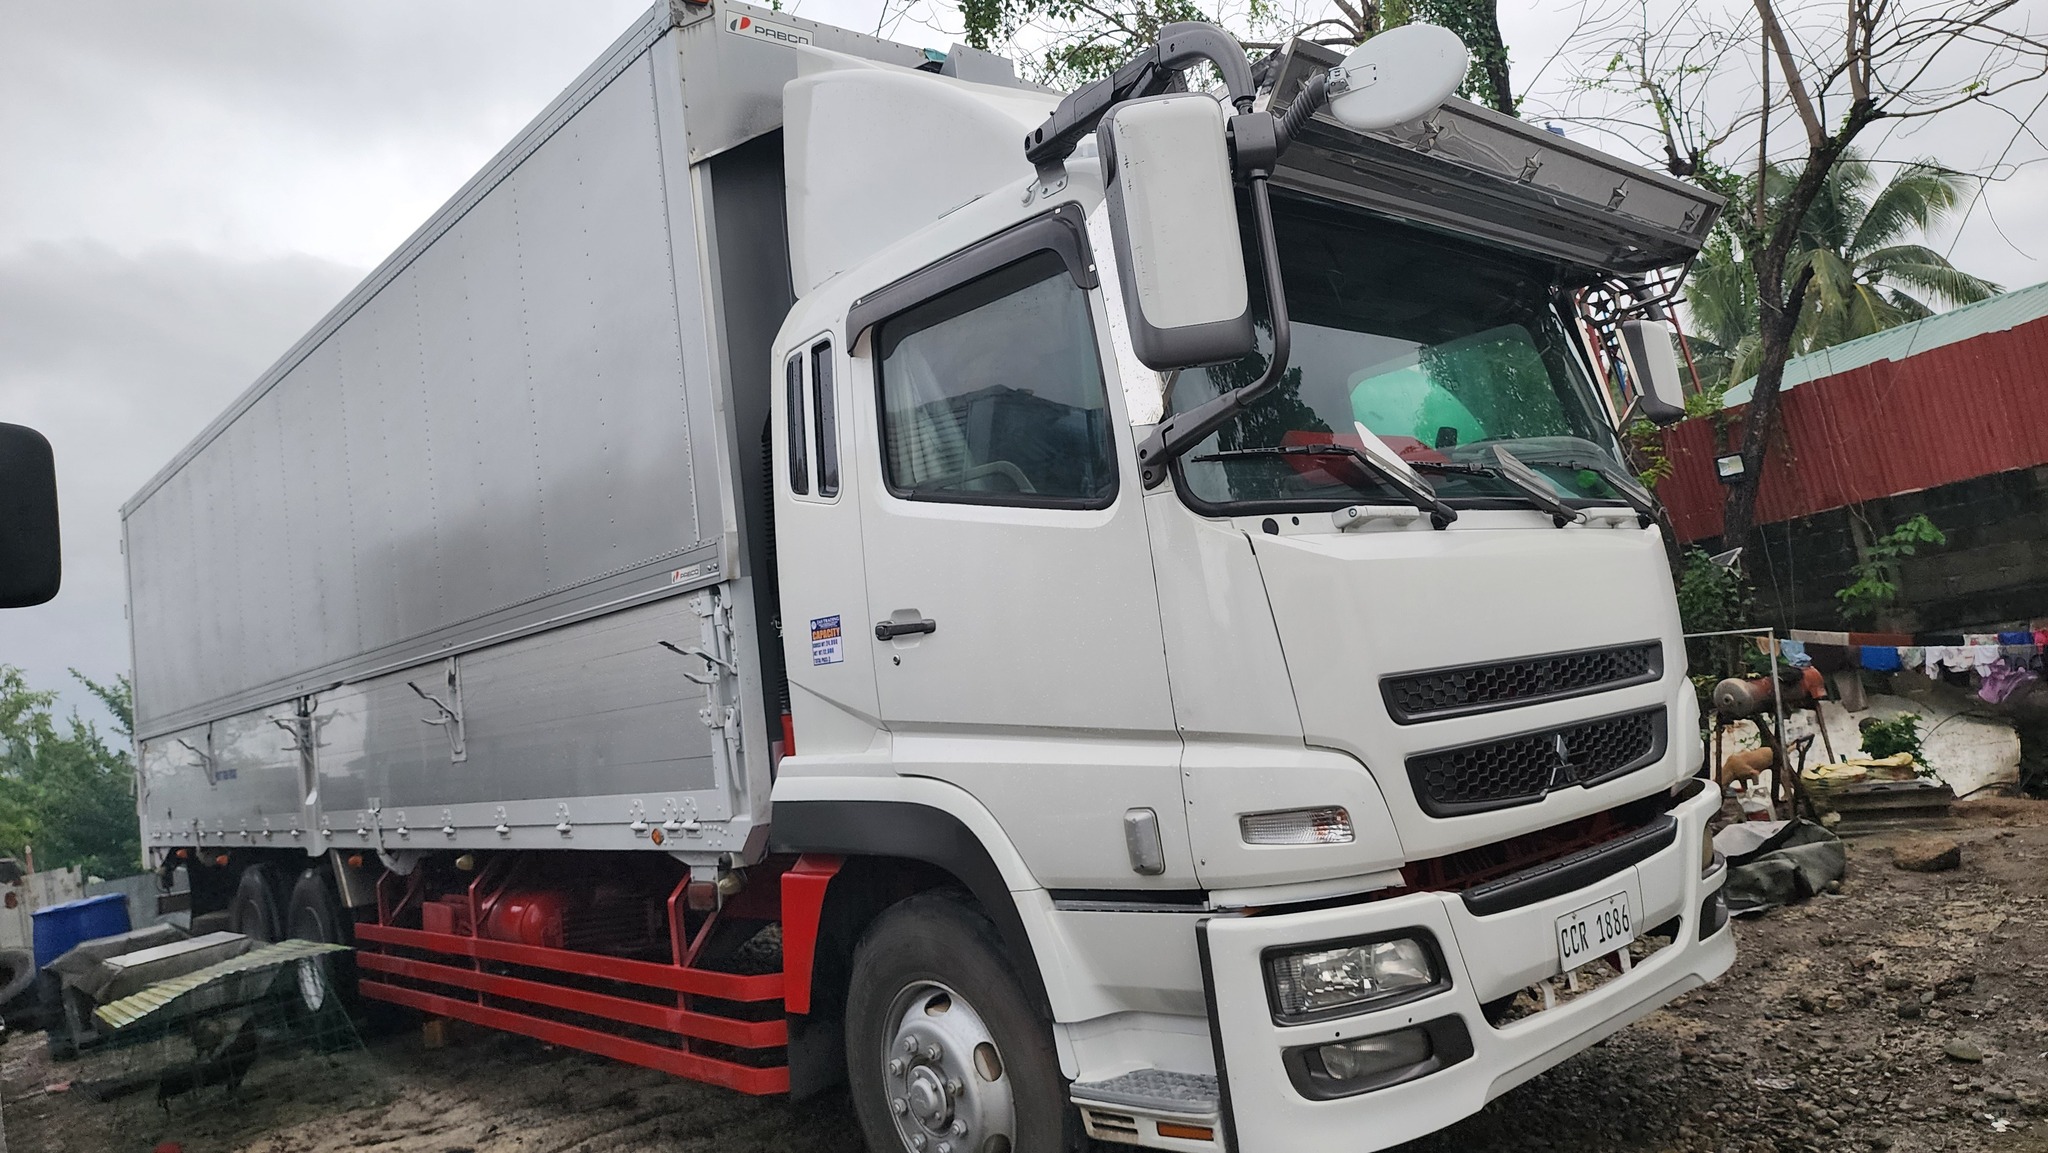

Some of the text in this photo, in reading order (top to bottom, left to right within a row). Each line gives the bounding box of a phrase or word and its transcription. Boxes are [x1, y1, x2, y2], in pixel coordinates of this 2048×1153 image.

[813, 628, 840, 640] CAPACITY
[1561, 904, 1630, 958] CCR 1886
